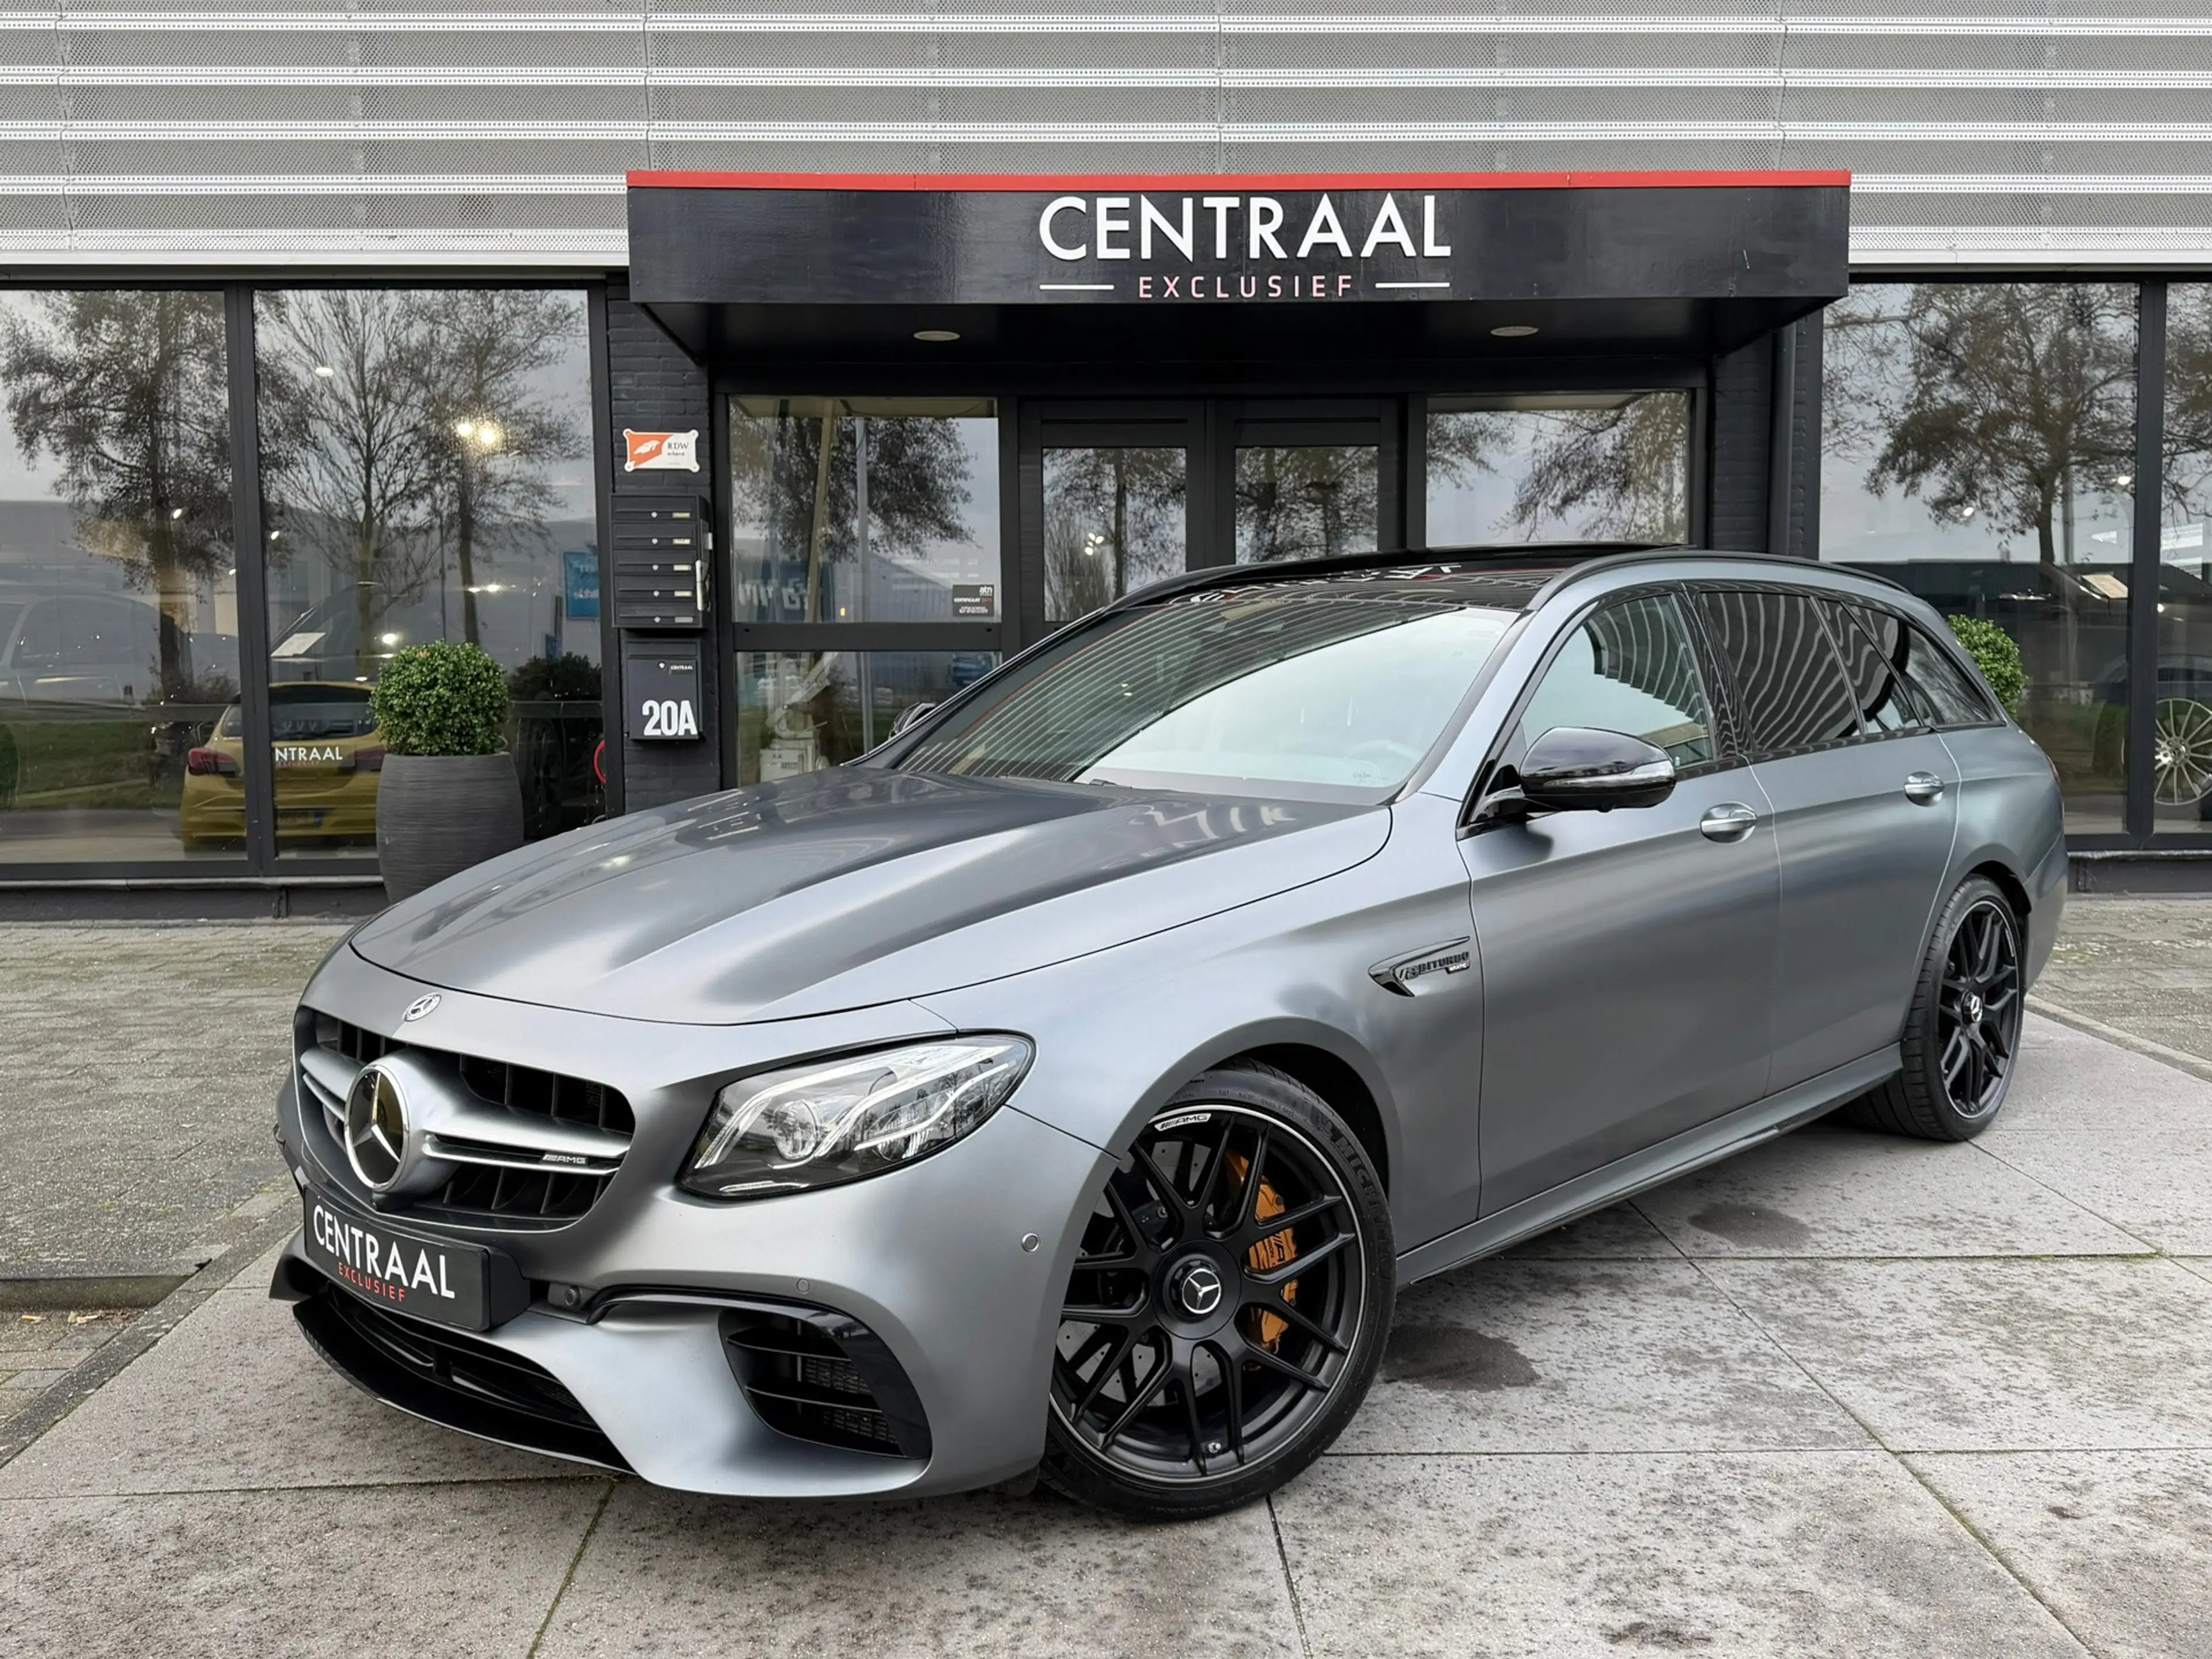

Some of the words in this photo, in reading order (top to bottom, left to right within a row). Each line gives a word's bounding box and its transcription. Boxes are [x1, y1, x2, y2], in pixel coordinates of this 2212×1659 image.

[1039, 192, 1451, 262] CENTRAAL
[1139, 275, 1353, 298] EXCLUSIEF
[667, 441, 689, 449] RDW
[642, 699, 698, 736] 20A
[274, 746, 343, 762] NTRAAL
[313, 1204, 456, 1300] CENTRAAL
[338, 1262, 405, 1302] EXCLUSIEF
